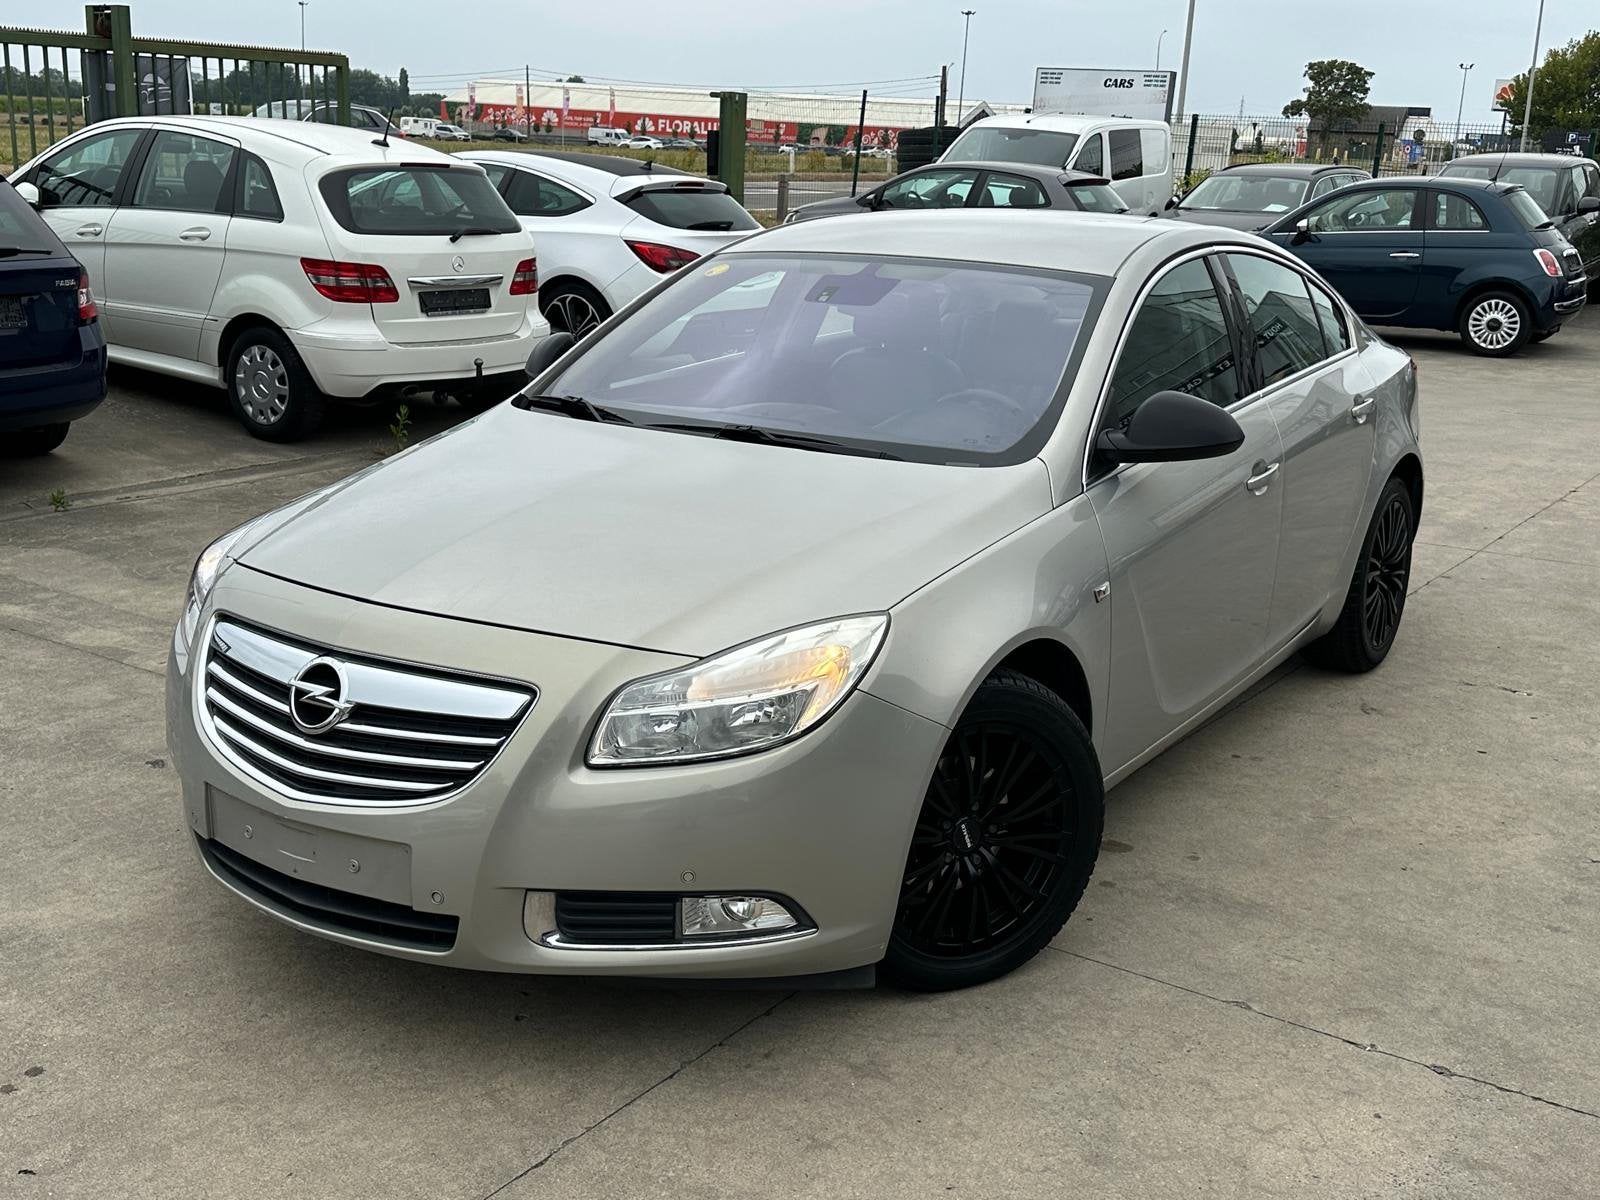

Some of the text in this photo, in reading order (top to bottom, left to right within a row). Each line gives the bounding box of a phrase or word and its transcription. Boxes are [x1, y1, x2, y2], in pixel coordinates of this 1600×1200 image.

[1104, 78, 1135, 88] CARS
[658, 119, 720, 134] FLORALU
[1568, 133, 1577, 142] P
